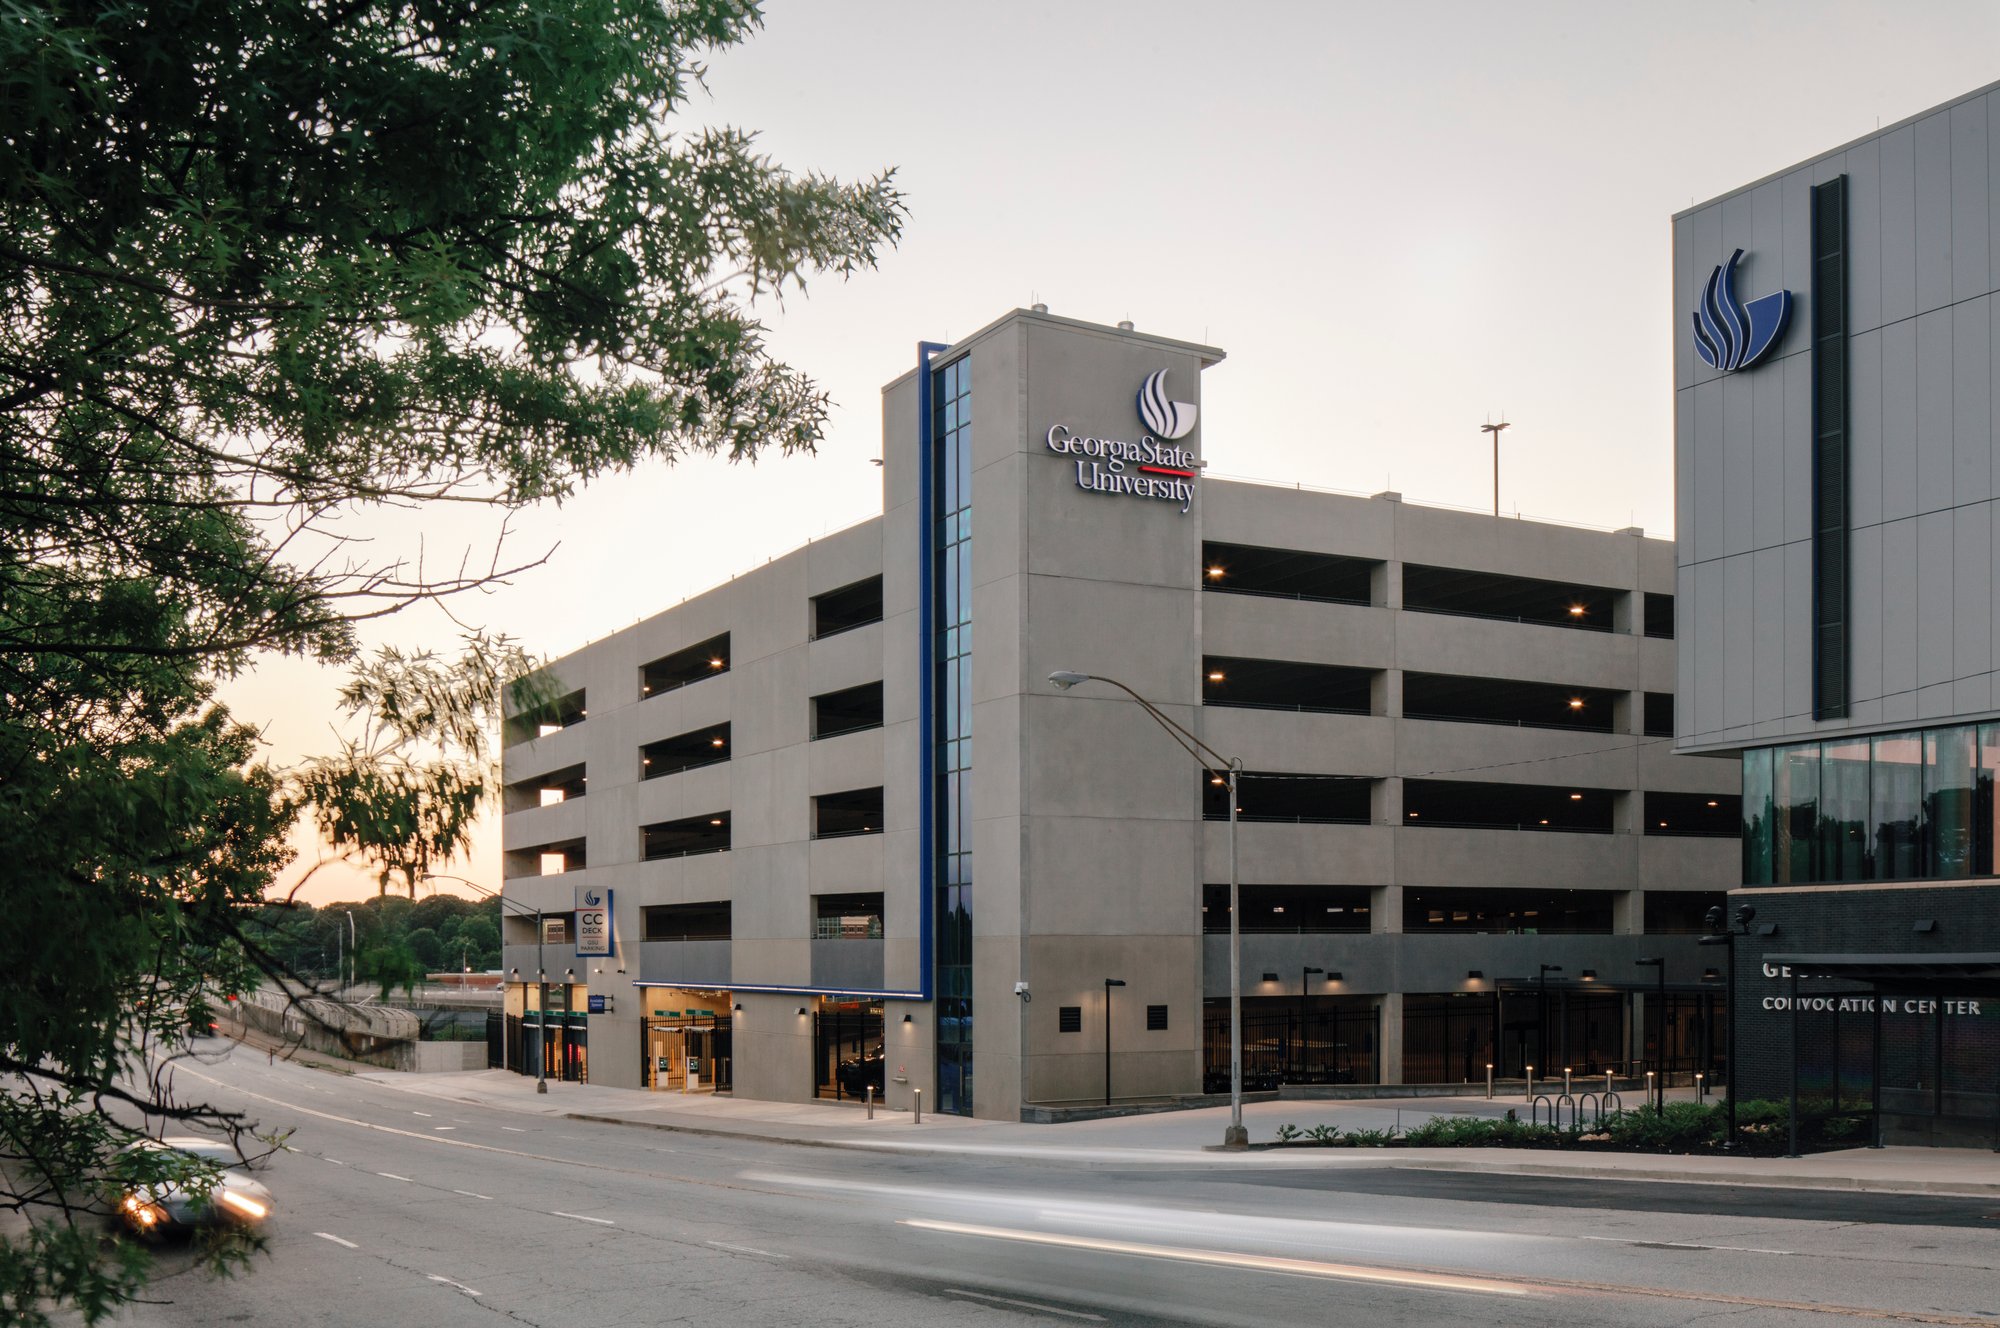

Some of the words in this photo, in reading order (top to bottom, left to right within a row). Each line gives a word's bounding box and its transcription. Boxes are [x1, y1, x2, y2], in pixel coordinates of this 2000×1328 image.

[1076, 460, 1195, 513] University
[582, 913, 603, 925] CC
[1904, 1000, 1981, 1015] CENTER
